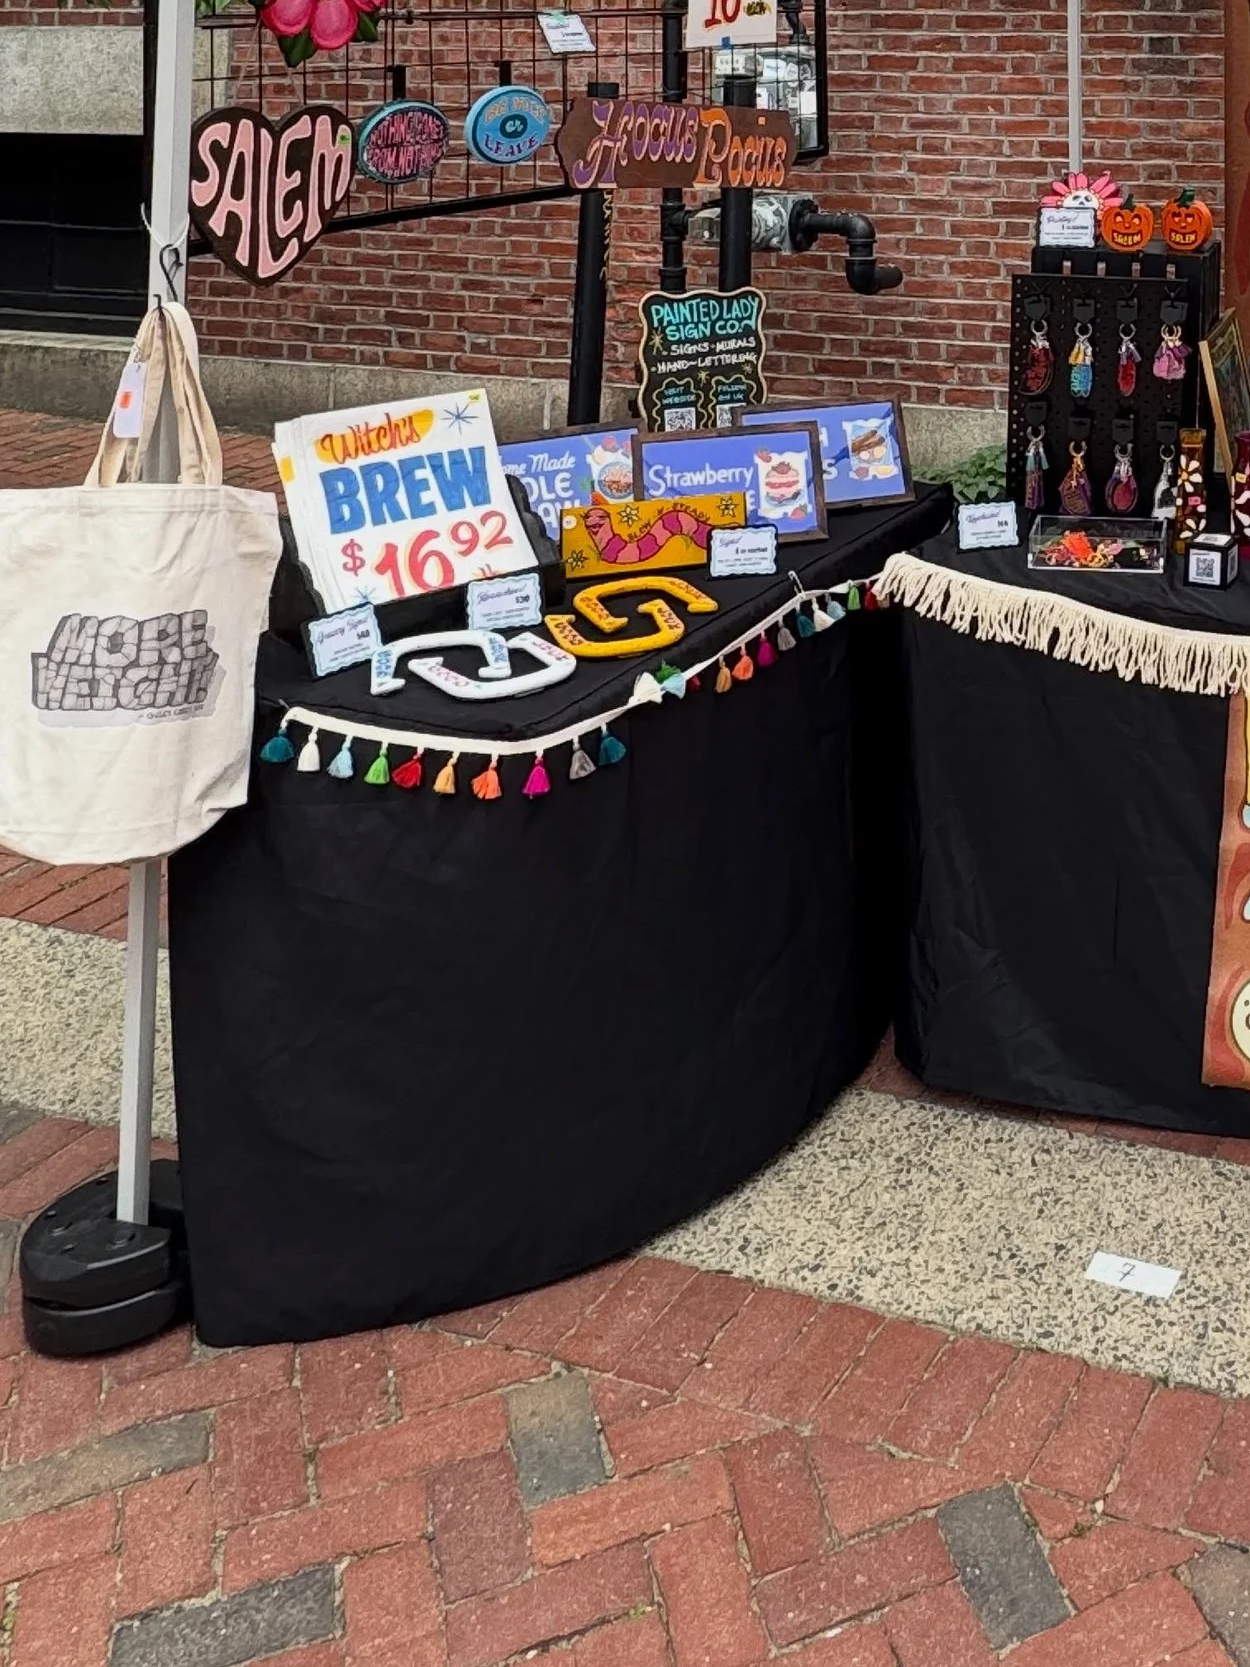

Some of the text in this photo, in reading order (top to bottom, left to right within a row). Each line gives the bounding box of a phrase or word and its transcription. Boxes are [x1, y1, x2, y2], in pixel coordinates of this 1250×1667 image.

[484, 133, 538, 156] LEAVE
[191, 115, 352, 278] SALEM
[651, 296, 759, 330] PAINTED LADY
[666, 320, 742, 341] SIGN CO.
[716, 337, 756, 352] MURALS
[320, 412, 420, 464] Witch's
[529, 451, 575, 470] Made
[319, 446, 492, 535] BREW
[524, 472, 575, 502] OLE
[648, 462, 754, 496] Strawberry
[49, 609, 208, 666] MORE
[1117, 1262, 1136, 1282] 7
